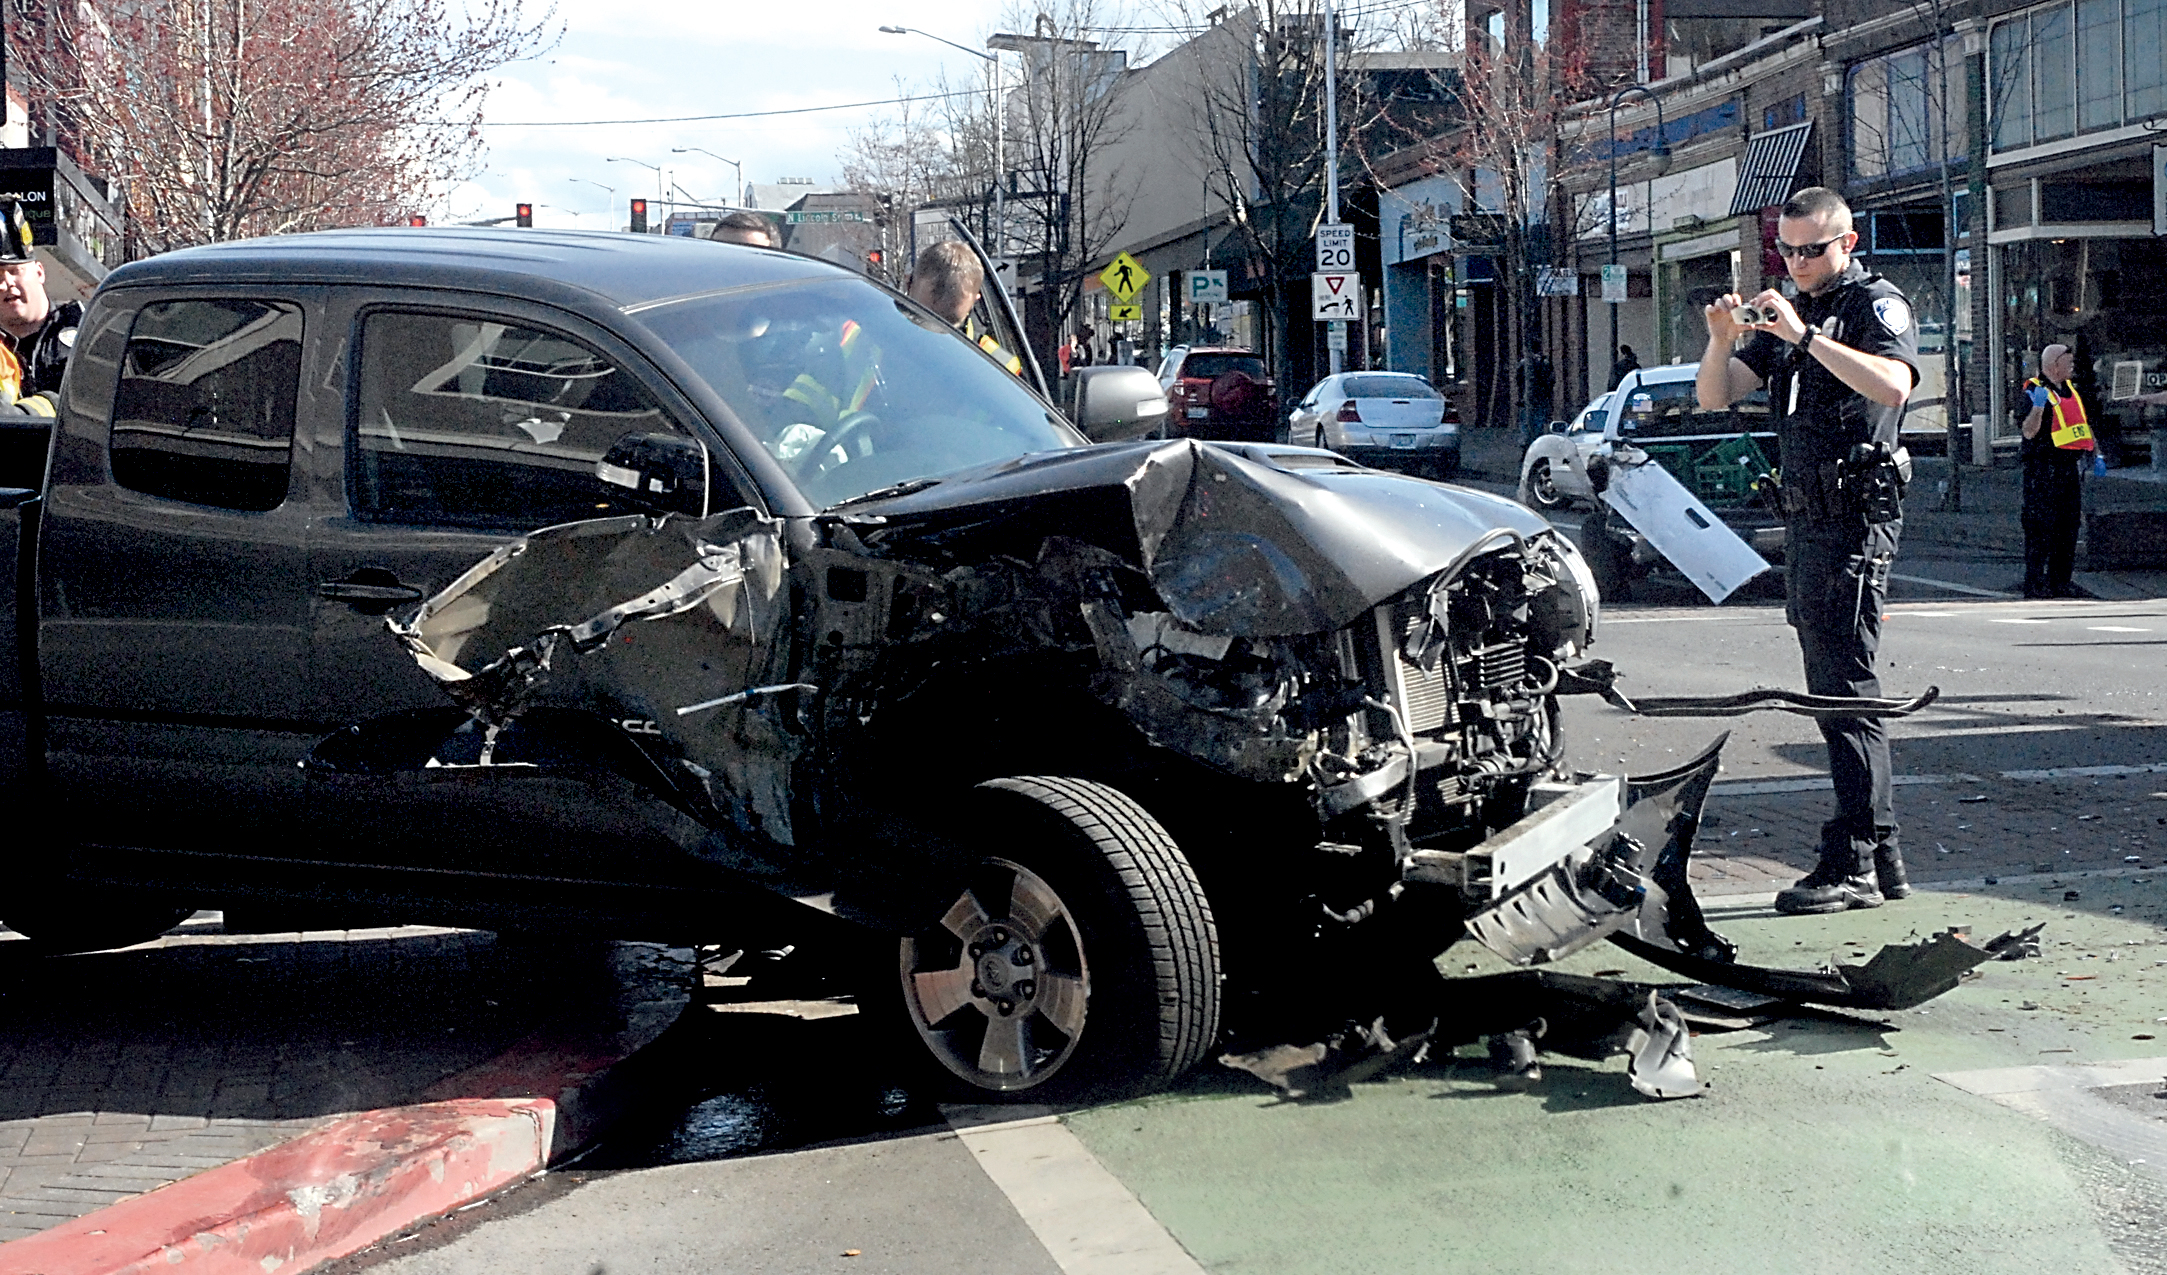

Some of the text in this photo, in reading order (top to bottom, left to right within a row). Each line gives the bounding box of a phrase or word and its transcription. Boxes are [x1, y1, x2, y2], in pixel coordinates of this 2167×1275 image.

[5, 191, 46, 202] LON
[788, 213, 794, 222] N
[1319, 229, 1351, 238] SPEED
[1323, 239, 1348, 247] LIMIT
[1321, 249, 1351, 266] 20
